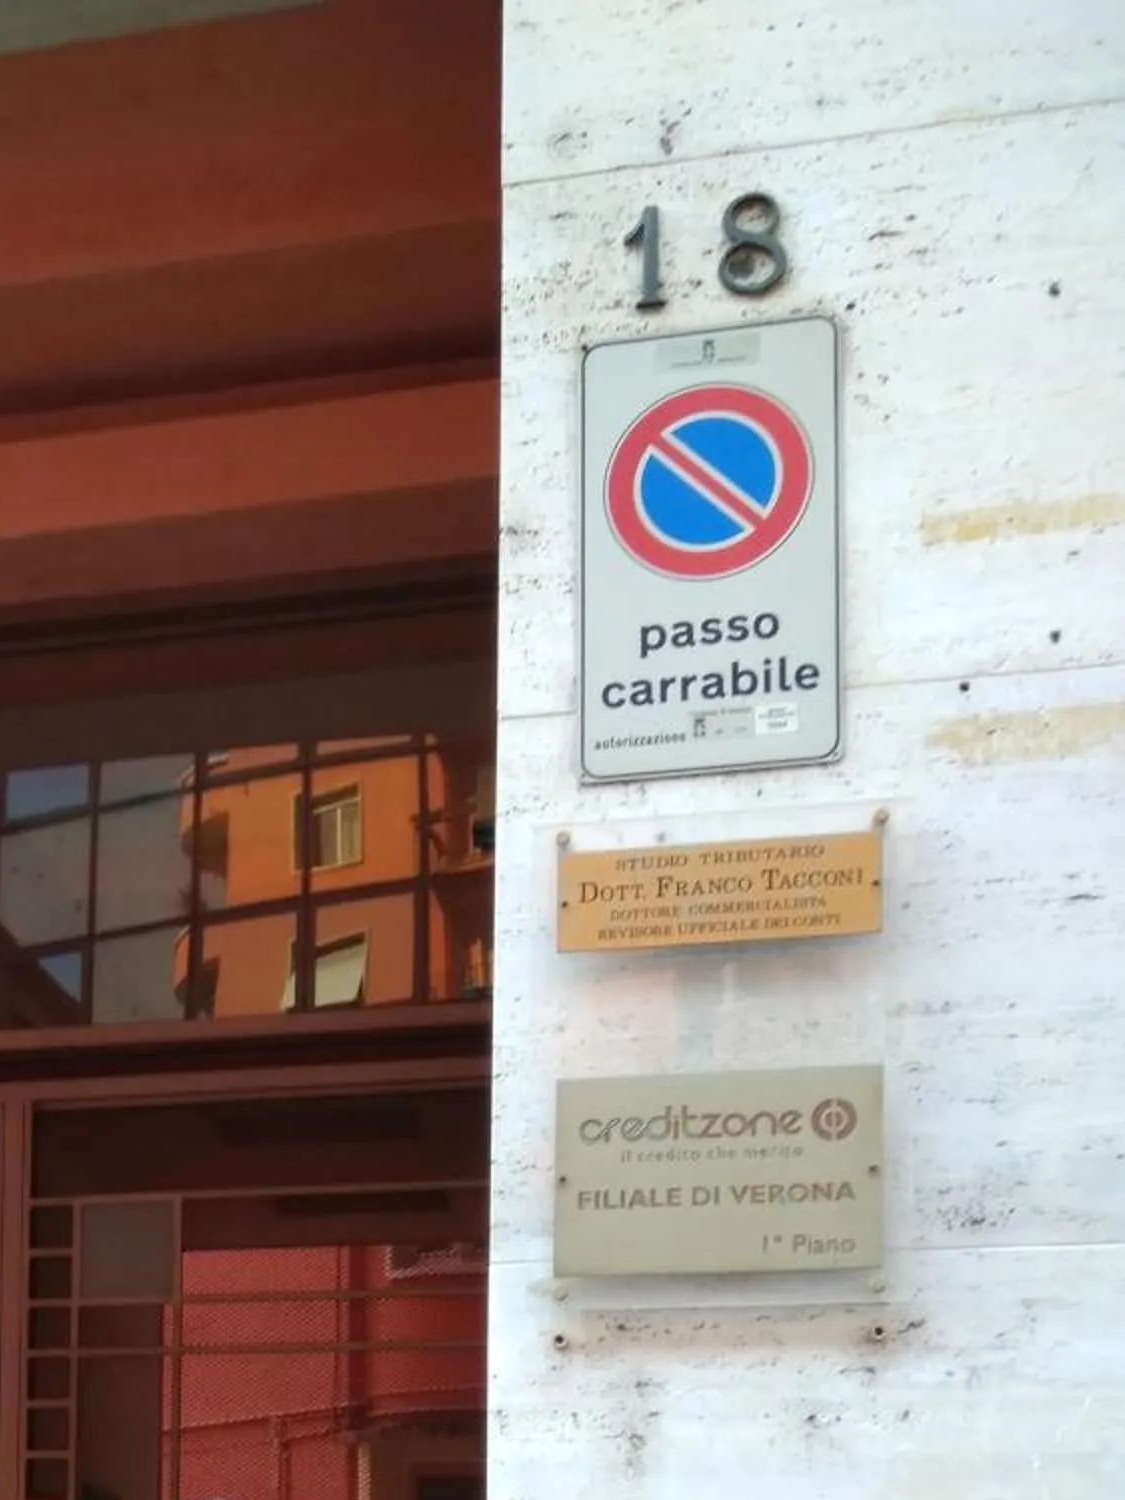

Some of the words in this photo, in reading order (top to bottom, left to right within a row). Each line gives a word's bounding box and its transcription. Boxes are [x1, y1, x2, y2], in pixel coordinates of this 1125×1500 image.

[623, 192, 789, 312] 18
[640, 612, 780, 658] passo
[601, 655, 820, 709] carrabile
[594, 732, 687, 750] autorizzazione
[615, 855, 688, 872] STUDIO
[700, 845, 825, 867] TRIBUTARIO
[657, 875, 752, 899] FRANCO
[761, 867, 864, 891] TACCONI
[610, 905, 679, 921] DOTTORE
[688, 896, 827, 916] COMMERCIALISTA
[598, 924, 672, 940] REVISORE
[678, 918, 759, 935] UFFICIALE
[579, 1104, 803, 1143] creditzone
[706, 1146, 737, 1159] che
[577, 1187, 682, 1210] FILIALE
[691, 1185, 720, 1206] DI
[730, 1181, 857, 1205] VERONA
[792, 1233, 857, 1255] Piano
